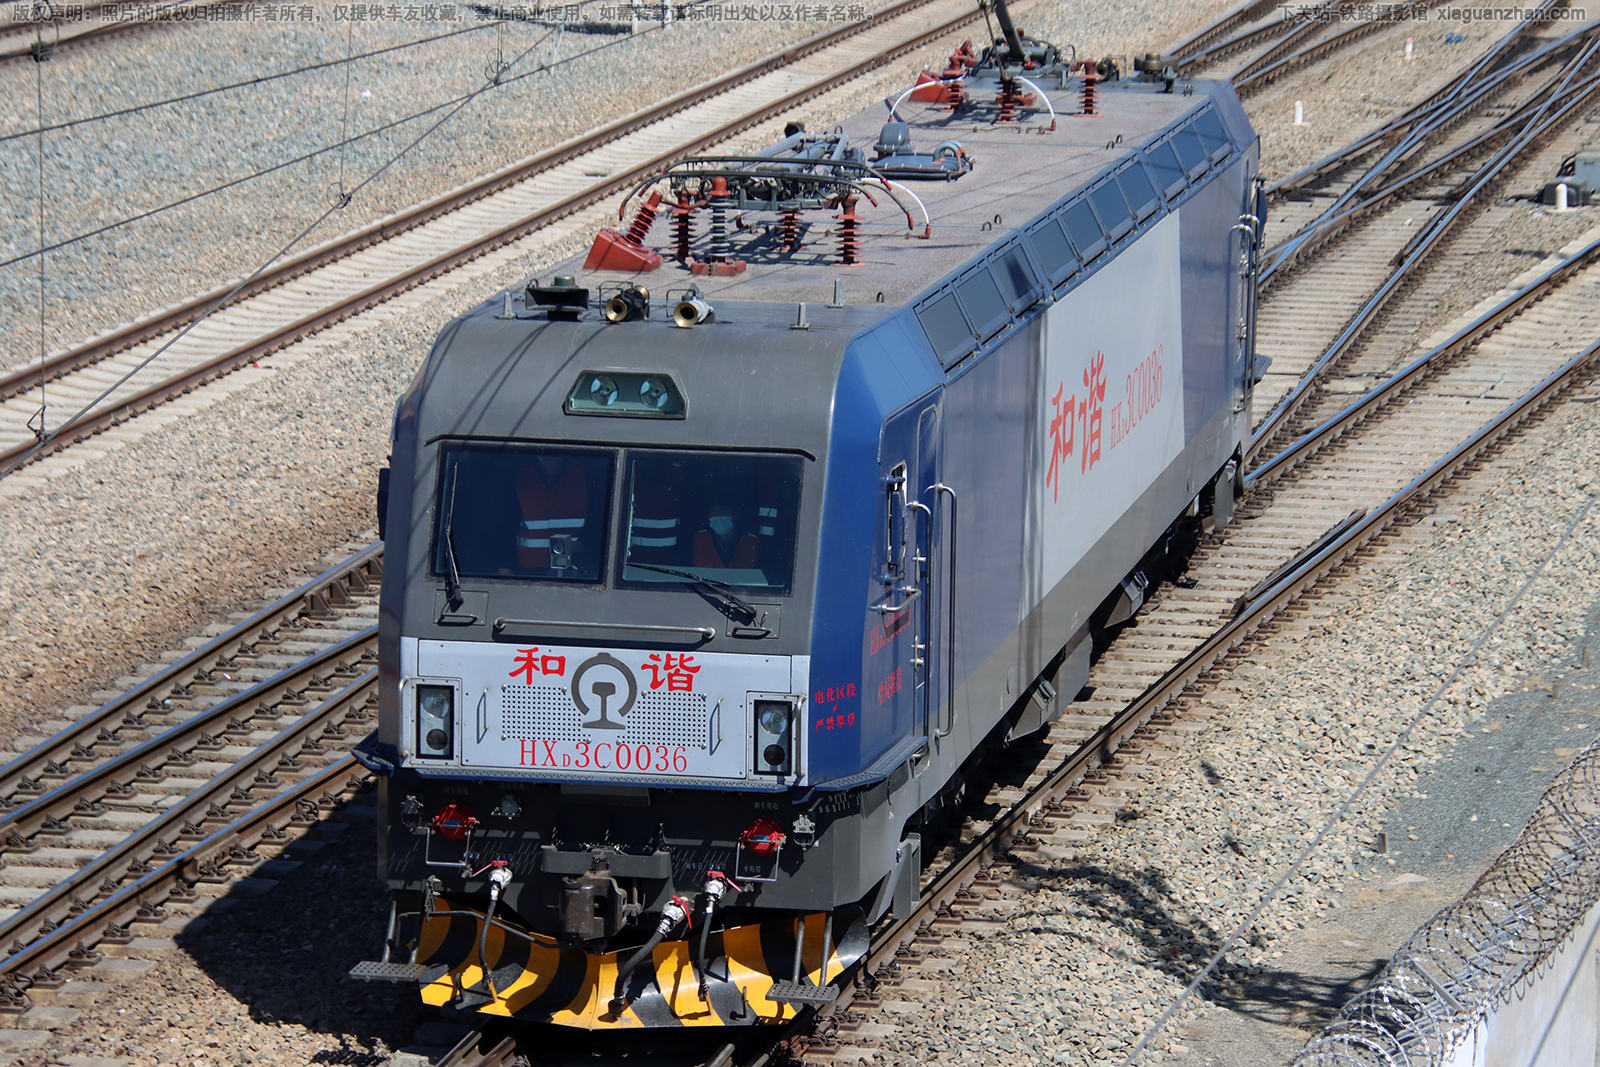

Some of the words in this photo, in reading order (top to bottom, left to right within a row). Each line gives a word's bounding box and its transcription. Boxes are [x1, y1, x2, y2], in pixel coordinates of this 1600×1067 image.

[1046, 349, 1107, 504] 和谐
[1110, 343, 1164, 450] HXD3C0036
[814, 683, 856, 704] 电化区段
[814, 712, 856, 734] 严禁攀登
[518, 738, 688, 773] HXD3C0036
